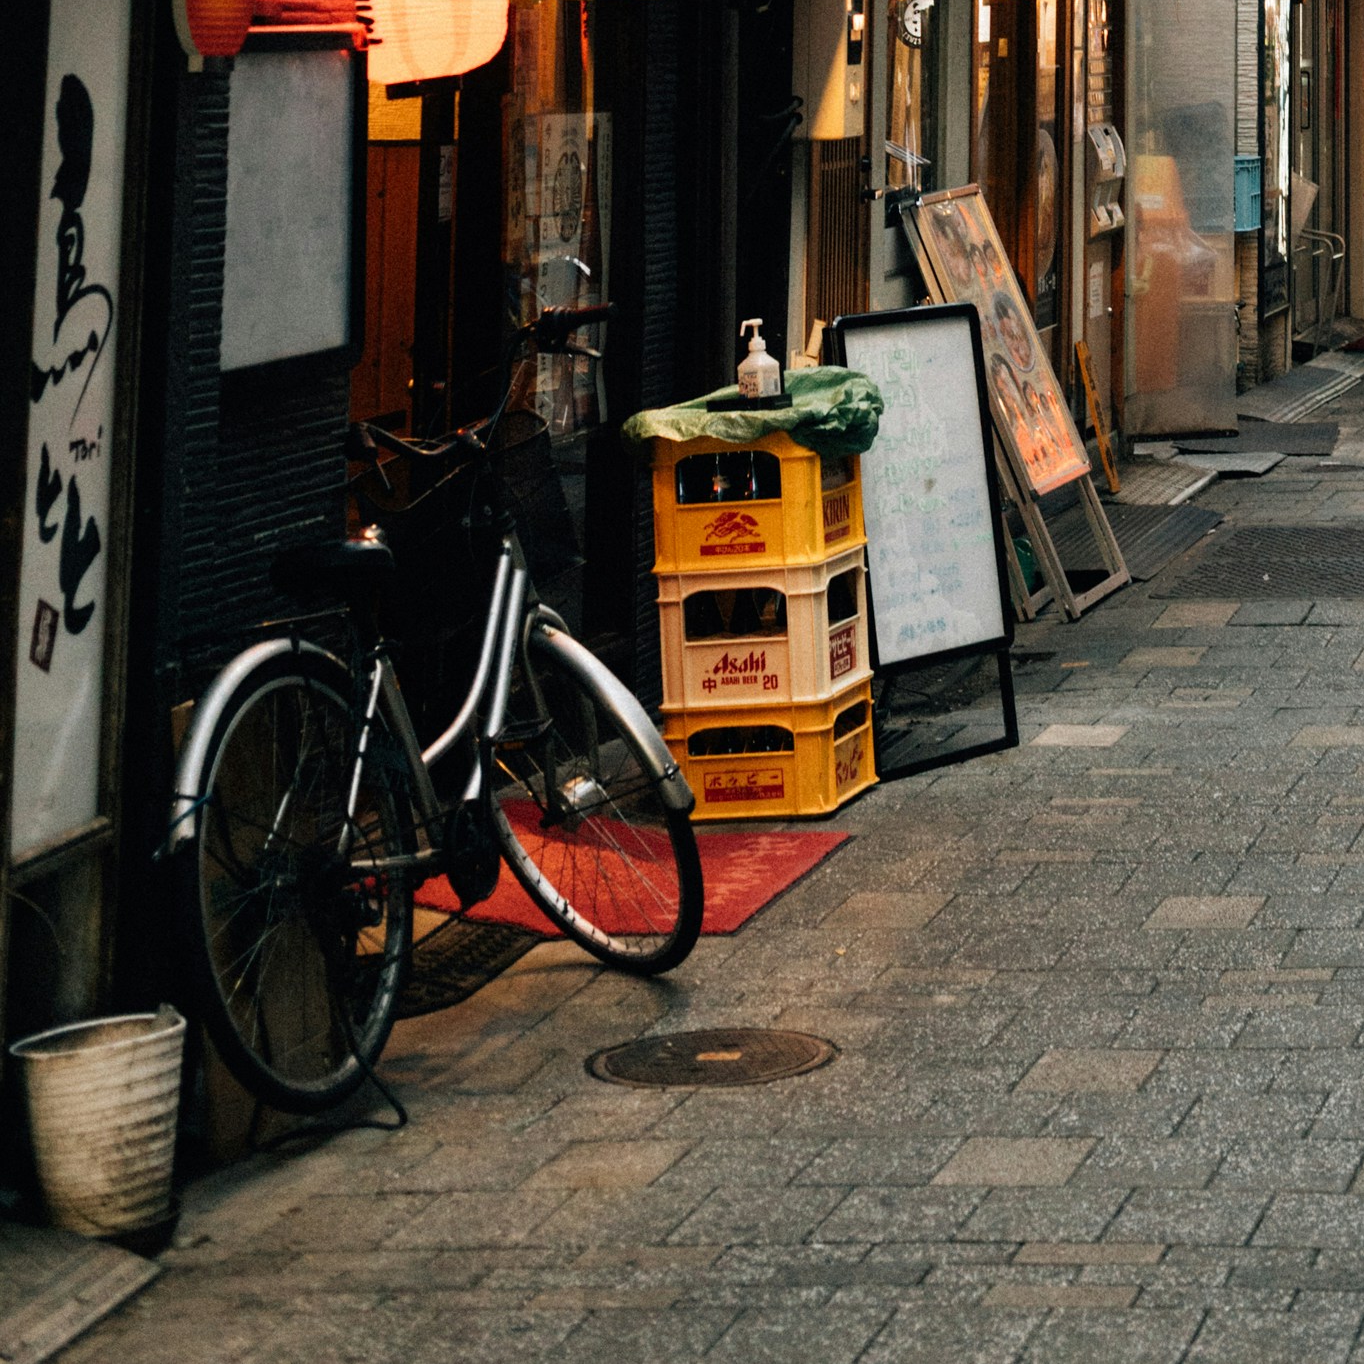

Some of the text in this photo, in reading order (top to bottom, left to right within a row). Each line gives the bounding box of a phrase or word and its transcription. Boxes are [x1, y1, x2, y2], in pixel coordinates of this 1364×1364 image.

[69, 424, 102, 463] Tori
[822, 494, 850, 528] KIRIN
[712, 650, 766, 676] Asahi
[702, 673, 779, 694] 中 ASAHI BEER 20
[708, 772, 780, 788] ホッピー
